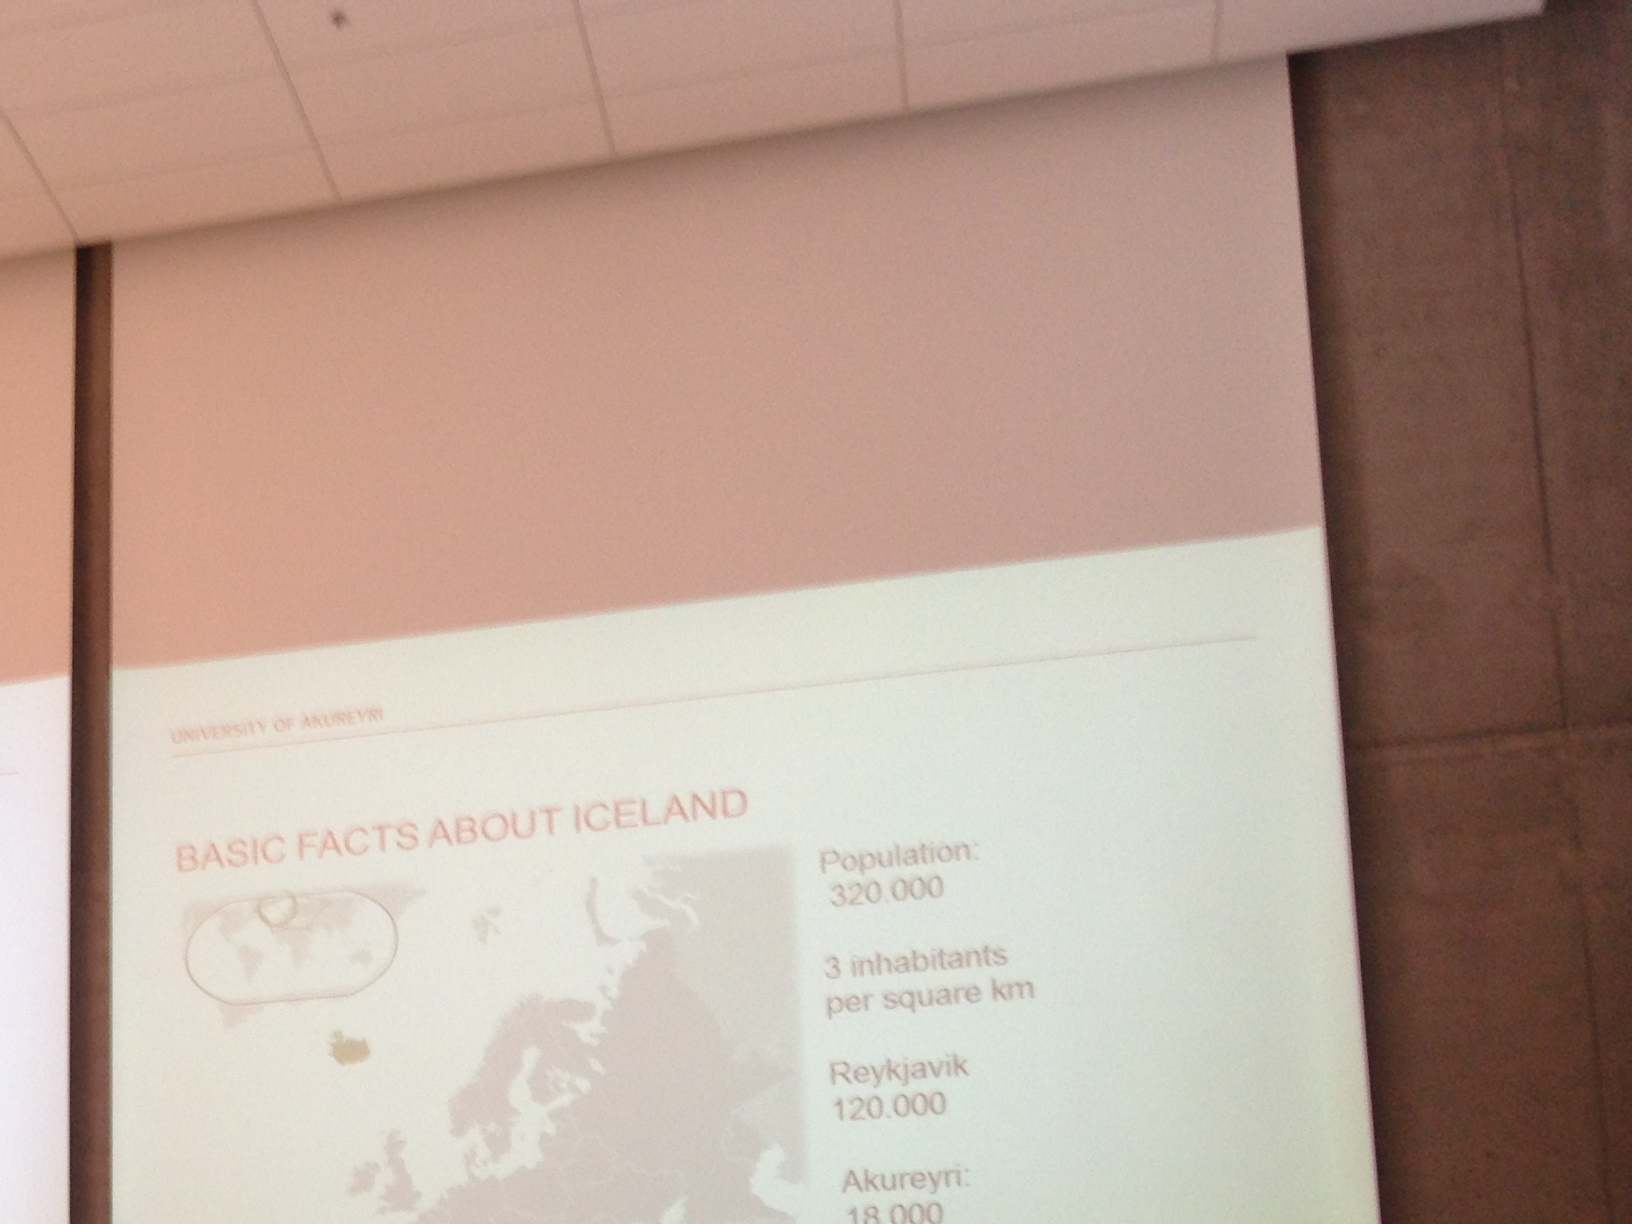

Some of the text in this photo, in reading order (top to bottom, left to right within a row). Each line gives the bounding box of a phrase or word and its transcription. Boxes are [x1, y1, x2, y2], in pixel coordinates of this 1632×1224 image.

[169, 707, 385, 744] UNIVERSITY OF AKUREYRI
[175, 787, 749, 873] BASIC FACTS ABOUT ICELAND
[820, 842, 980, 876] Population:
[831, 875, 945, 908] 320.000
[825, 946, 1009, 980] 3 inhabitants
[826, 977, 1036, 1020] per square km
[829, 1052, 970, 1088] Reykjavik
[834, 1091, 947, 1121] 120.000
[841, 1163, 971, 1194] Akureyri:
